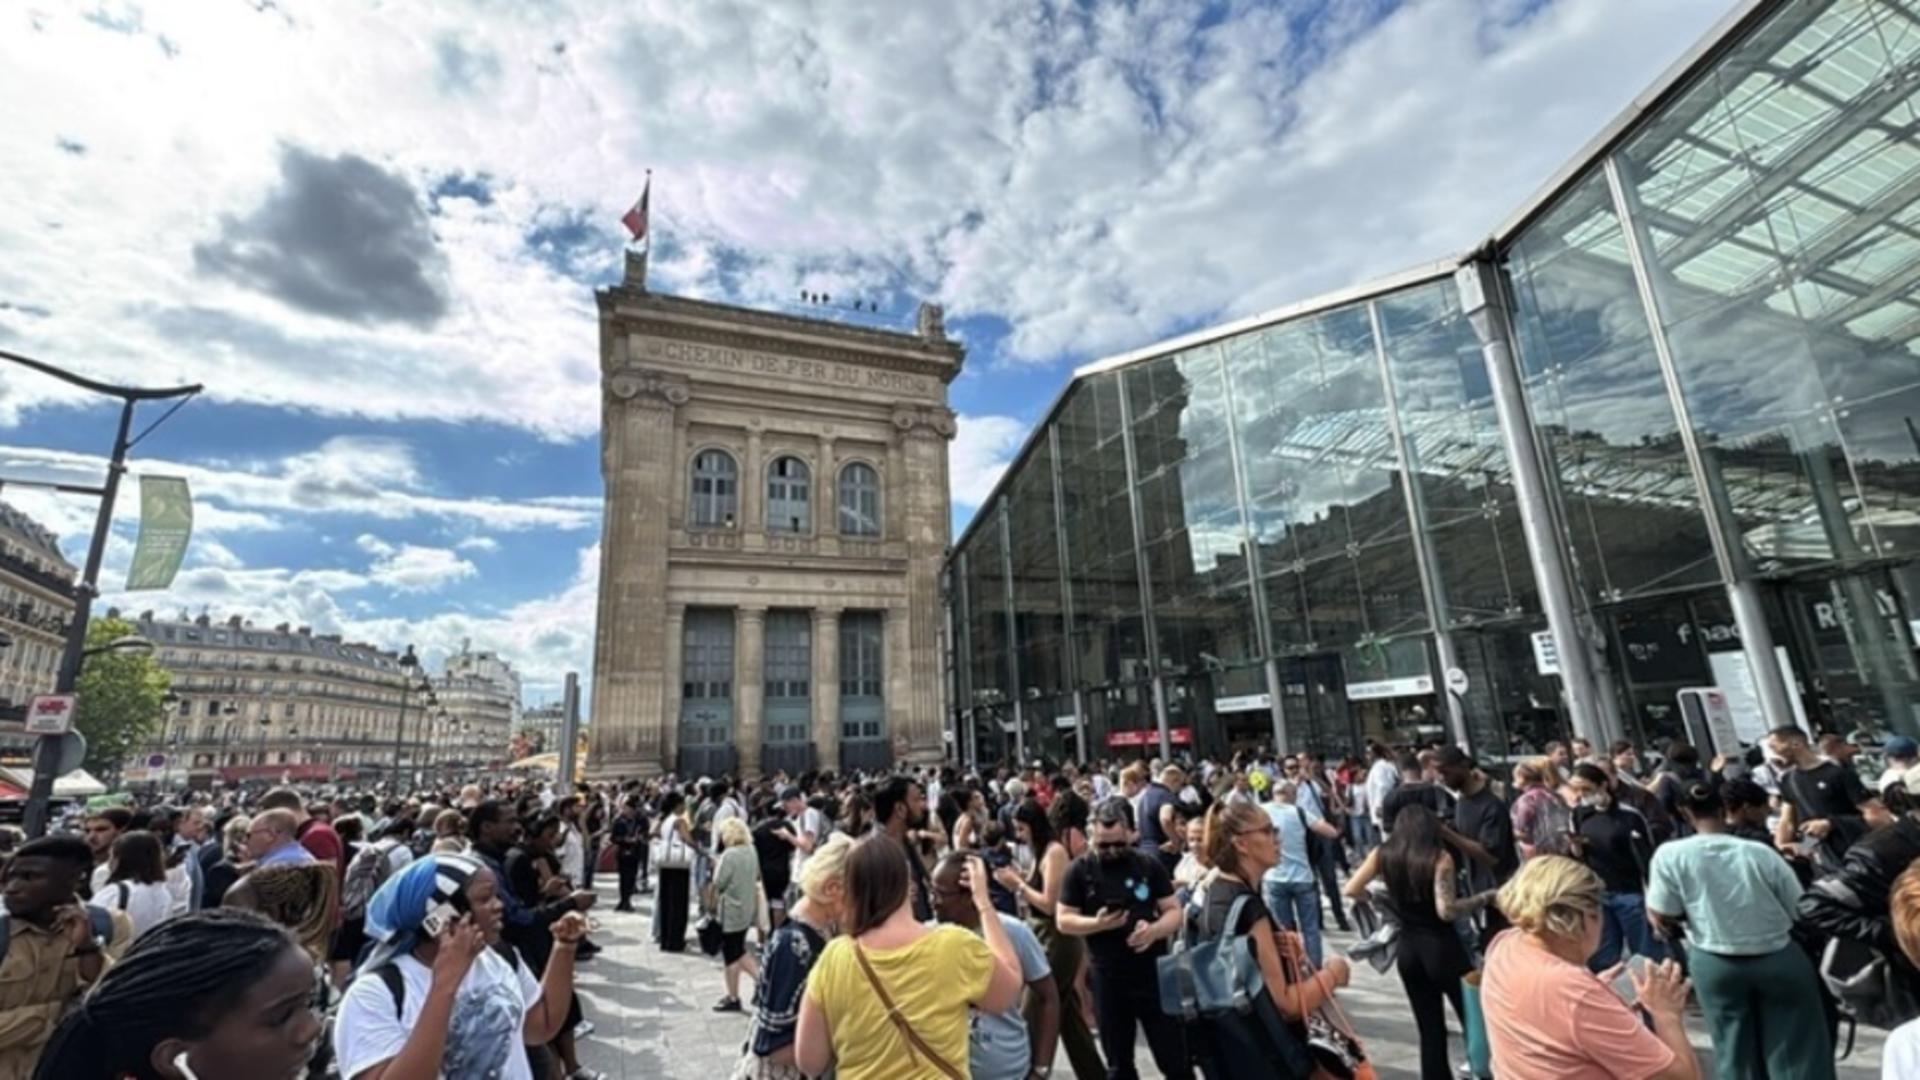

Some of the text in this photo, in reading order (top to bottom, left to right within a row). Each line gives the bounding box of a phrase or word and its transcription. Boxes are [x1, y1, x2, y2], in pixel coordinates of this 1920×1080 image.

[665, 342, 914, 392] CHEMIN DE FER DU NORD
